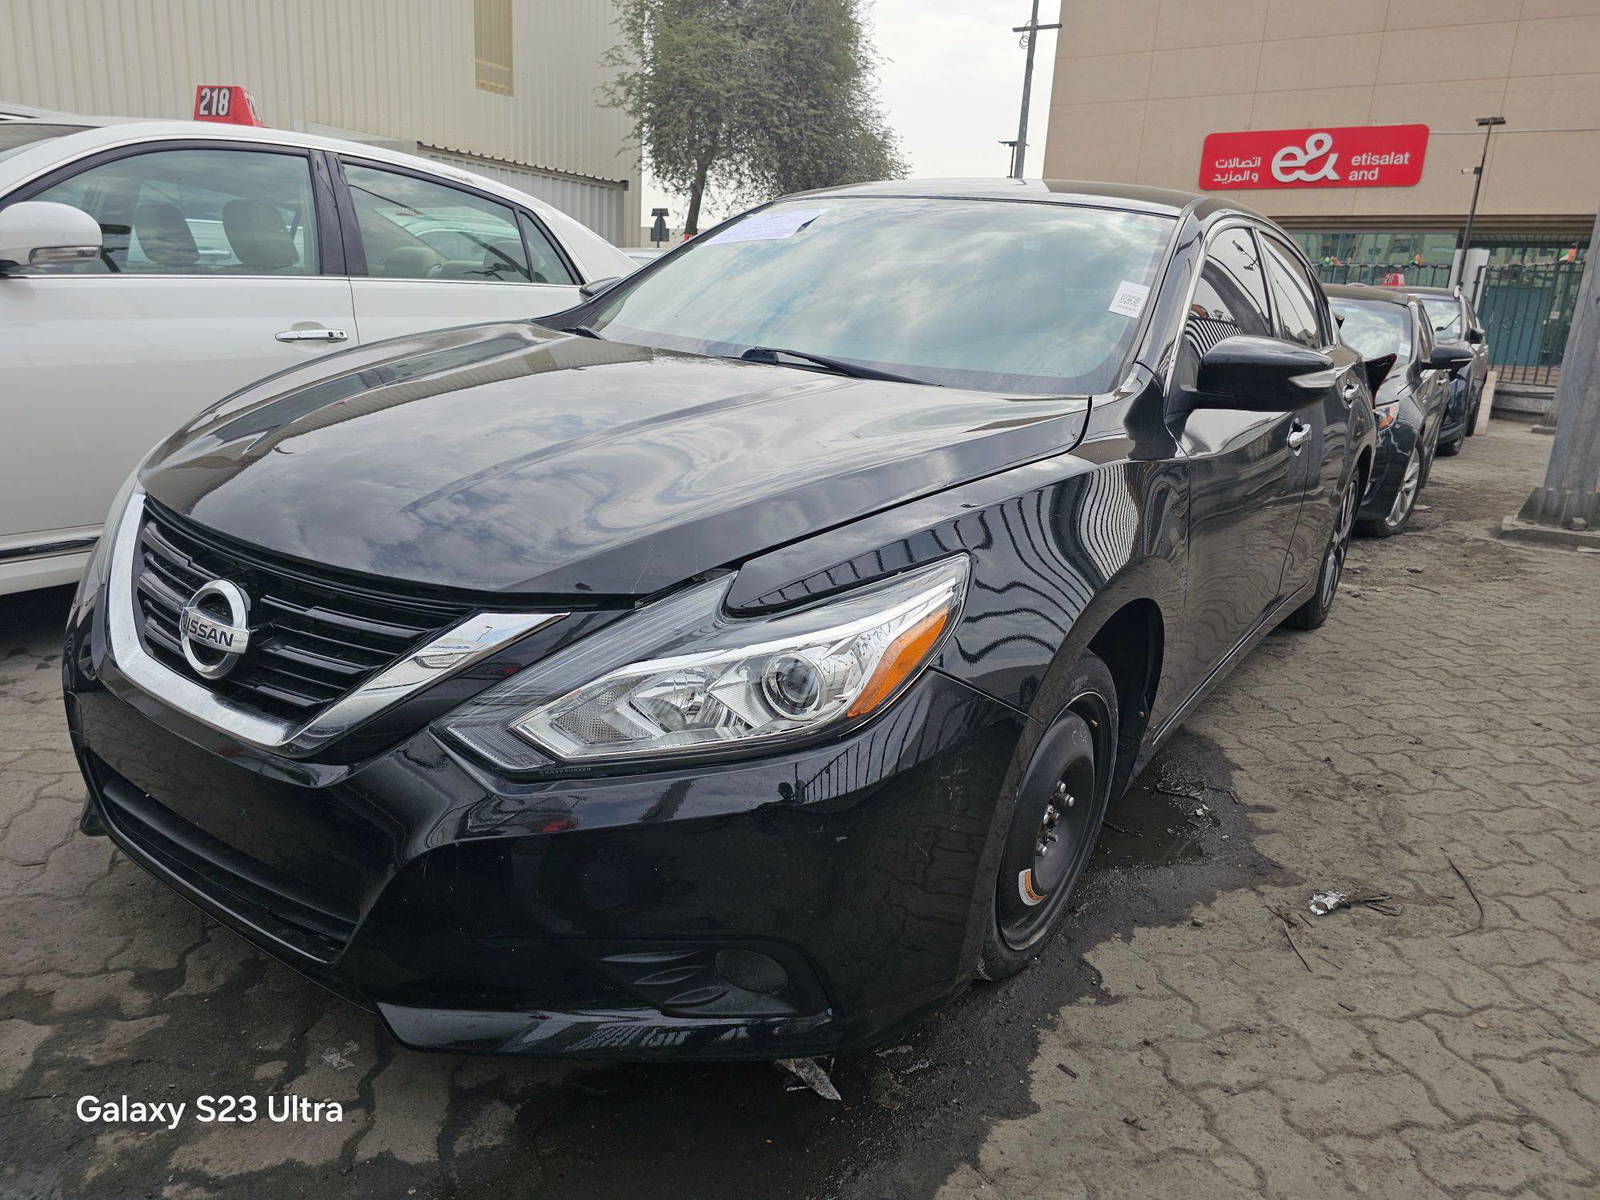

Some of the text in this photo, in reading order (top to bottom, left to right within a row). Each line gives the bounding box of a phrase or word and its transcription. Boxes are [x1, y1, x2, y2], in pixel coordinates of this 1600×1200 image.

[199, 87, 231, 116] 218
[1214, 156, 1262, 169] اتصالات
[1350, 151, 1411, 167] etisalat
[1348, 167, 1379, 181] and
